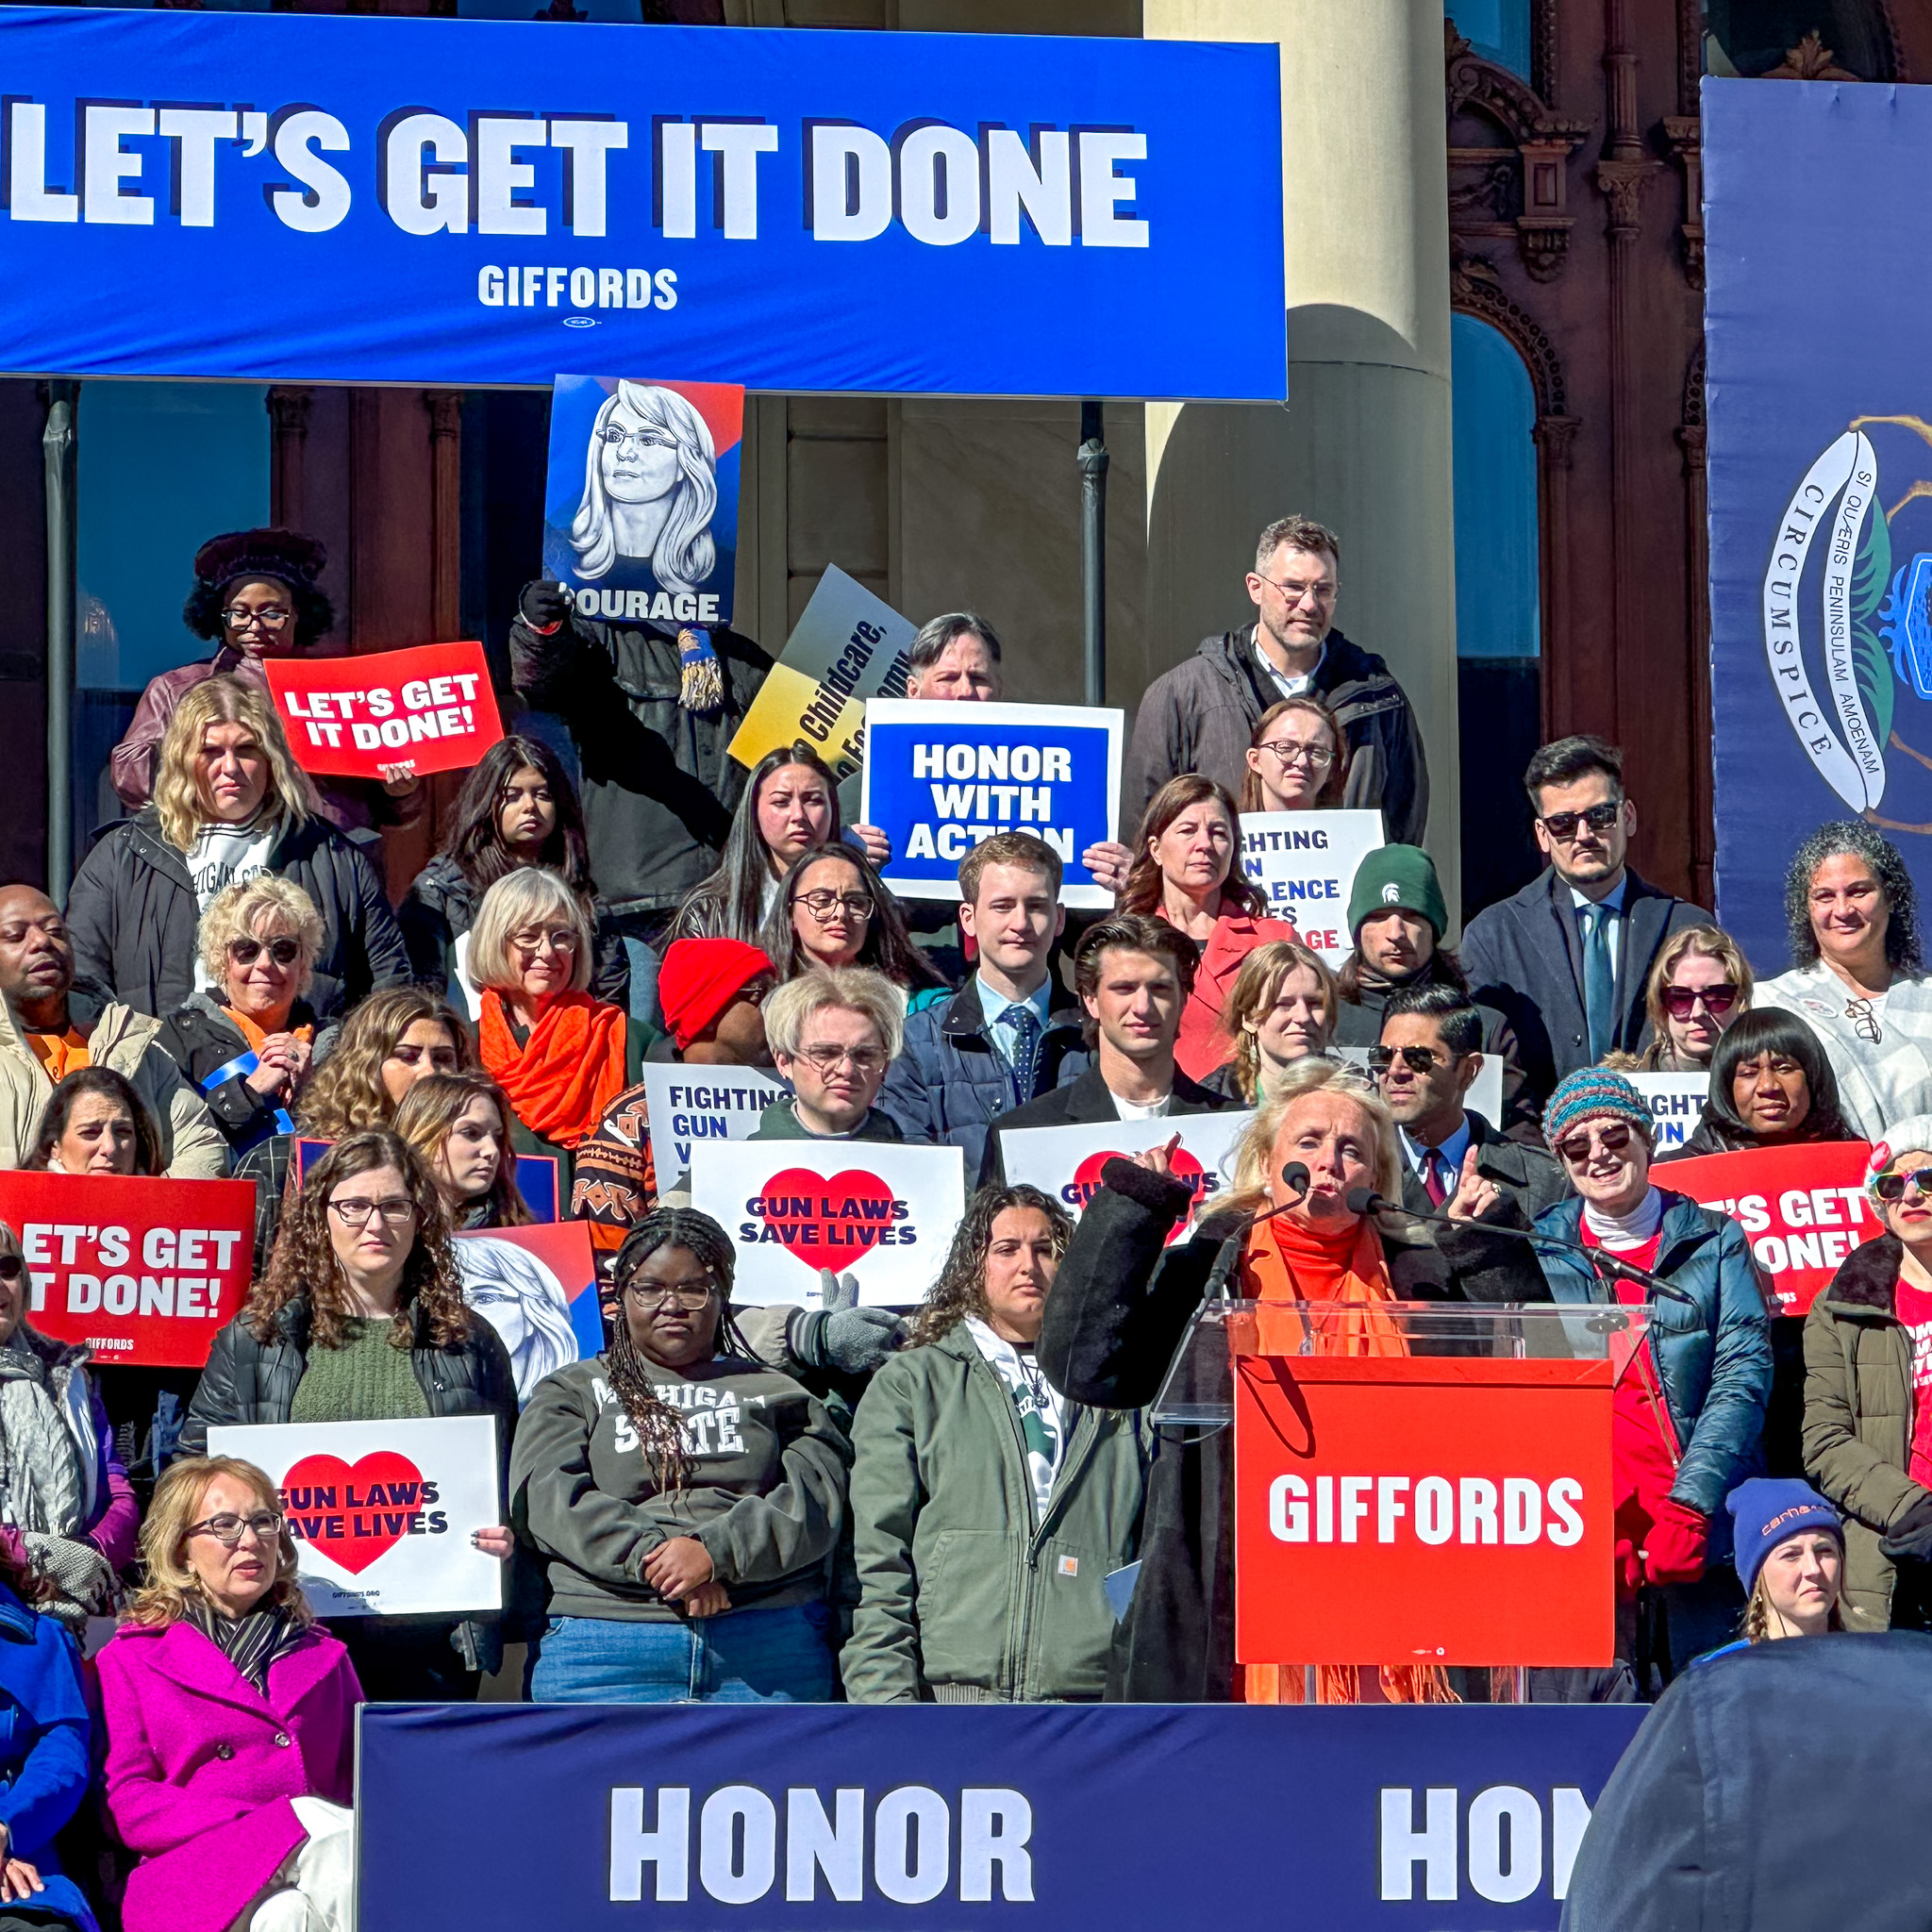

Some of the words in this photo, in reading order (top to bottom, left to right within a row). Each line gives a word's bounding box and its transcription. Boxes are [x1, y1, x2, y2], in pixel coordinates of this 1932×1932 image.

[8, 101, 352, 233] LET'S
[386, 113, 629, 236] GET
[661, 123, 779, 240] IT
[811, 125, 1150, 248] DONE
[477, 265, 678, 310] GIFFORDS
[1856, 471, 1872, 488] SI
[1771, 484, 1832, 755] CIRCUMSPICE
[1828, 575, 1849, 681] PENINSULAM
[284, 688, 376, 719] LET'S
[401, 673, 479, 711] GET
[799, 620, 888, 742] Childcare,
[305, 721, 342, 748] IT
[351, 705, 475, 750] DONE!
[1839, 693, 1880, 774] AMOENAM
[912, 743, 1072, 782] HONOR
[929, 784, 1052, 822] WITH
[905, 824, 1074, 864] ACTN
[673, 1114, 728, 1138] GUN
[745, 1196, 813, 1218] GUN
[821, 1198, 909, 1220] LAWS
[1779, 1186, 1867, 1228] GET
[22, 1223, 131, 1267] ET'S
[142, 1227, 242, 1270] GET
[739, 1223, 820, 1244] SAVE
[827, 1224, 917, 1245] LIVES
[1753, 1230, 1861, 1274] ONE!
[29, 1272, 56, 1311] T
[67, 1274, 222, 1318] DONE!
[345, 1481, 441, 1507] LAWS
[1268, 1474, 1585, 1547] GIFFORDS
[287, 1515, 345, 1540] AVE
[353, 1510, 448, 1538] LIVES
[608, 1785, 1036, 1905] HONOR
